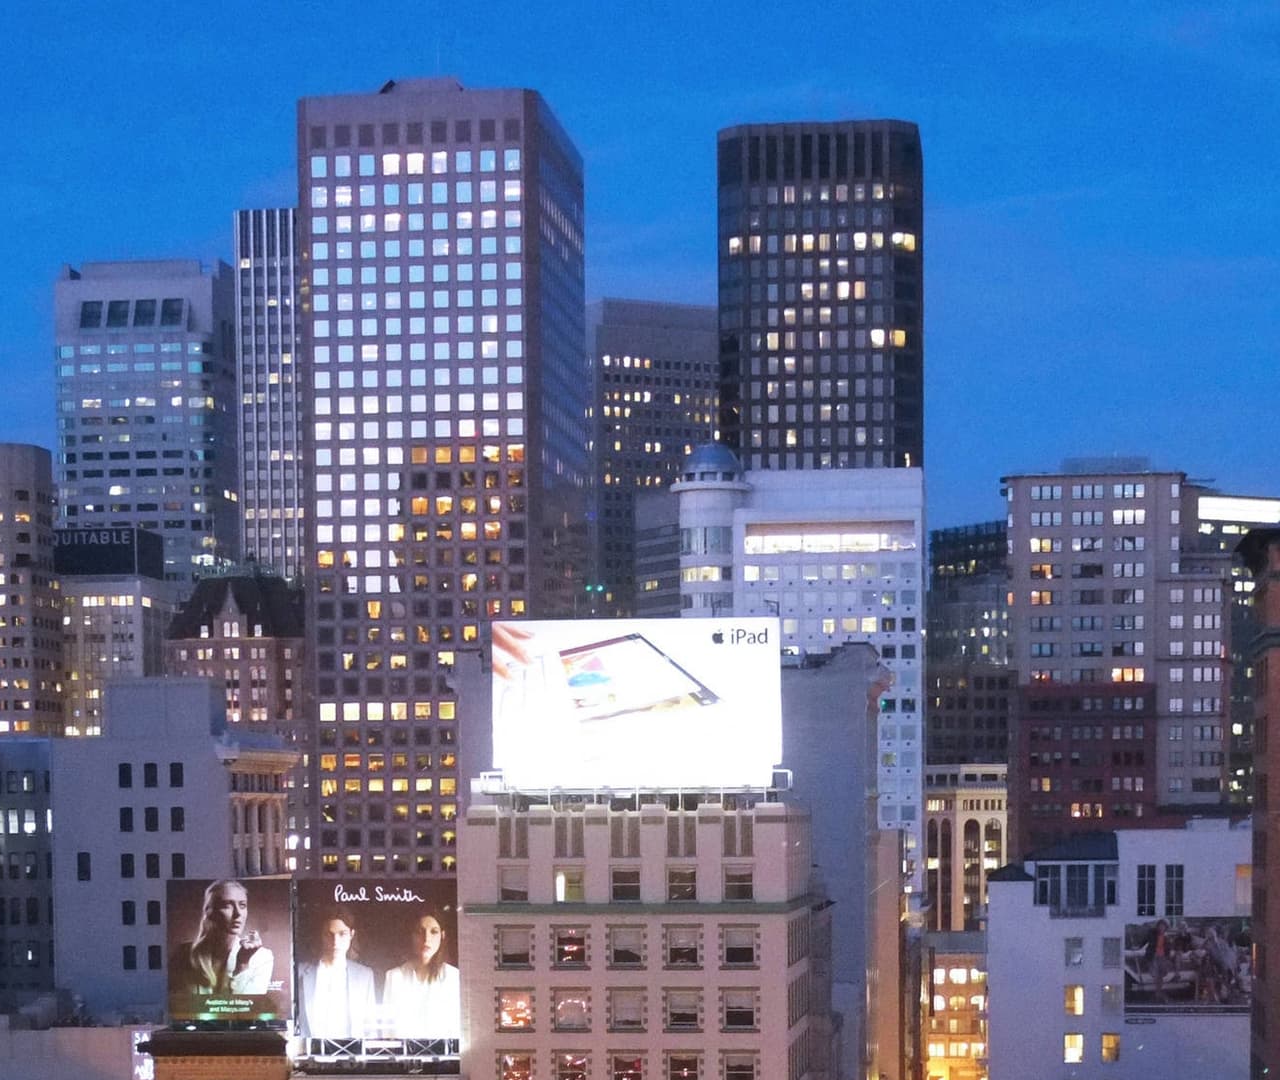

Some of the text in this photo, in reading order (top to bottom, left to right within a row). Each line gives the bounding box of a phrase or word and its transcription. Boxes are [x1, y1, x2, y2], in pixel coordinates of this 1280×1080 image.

[53, 531, 130, 546] QUITABLE
[731, 628, 768, 644] iPad
[334, 884, 425, 902] Paul Smith
